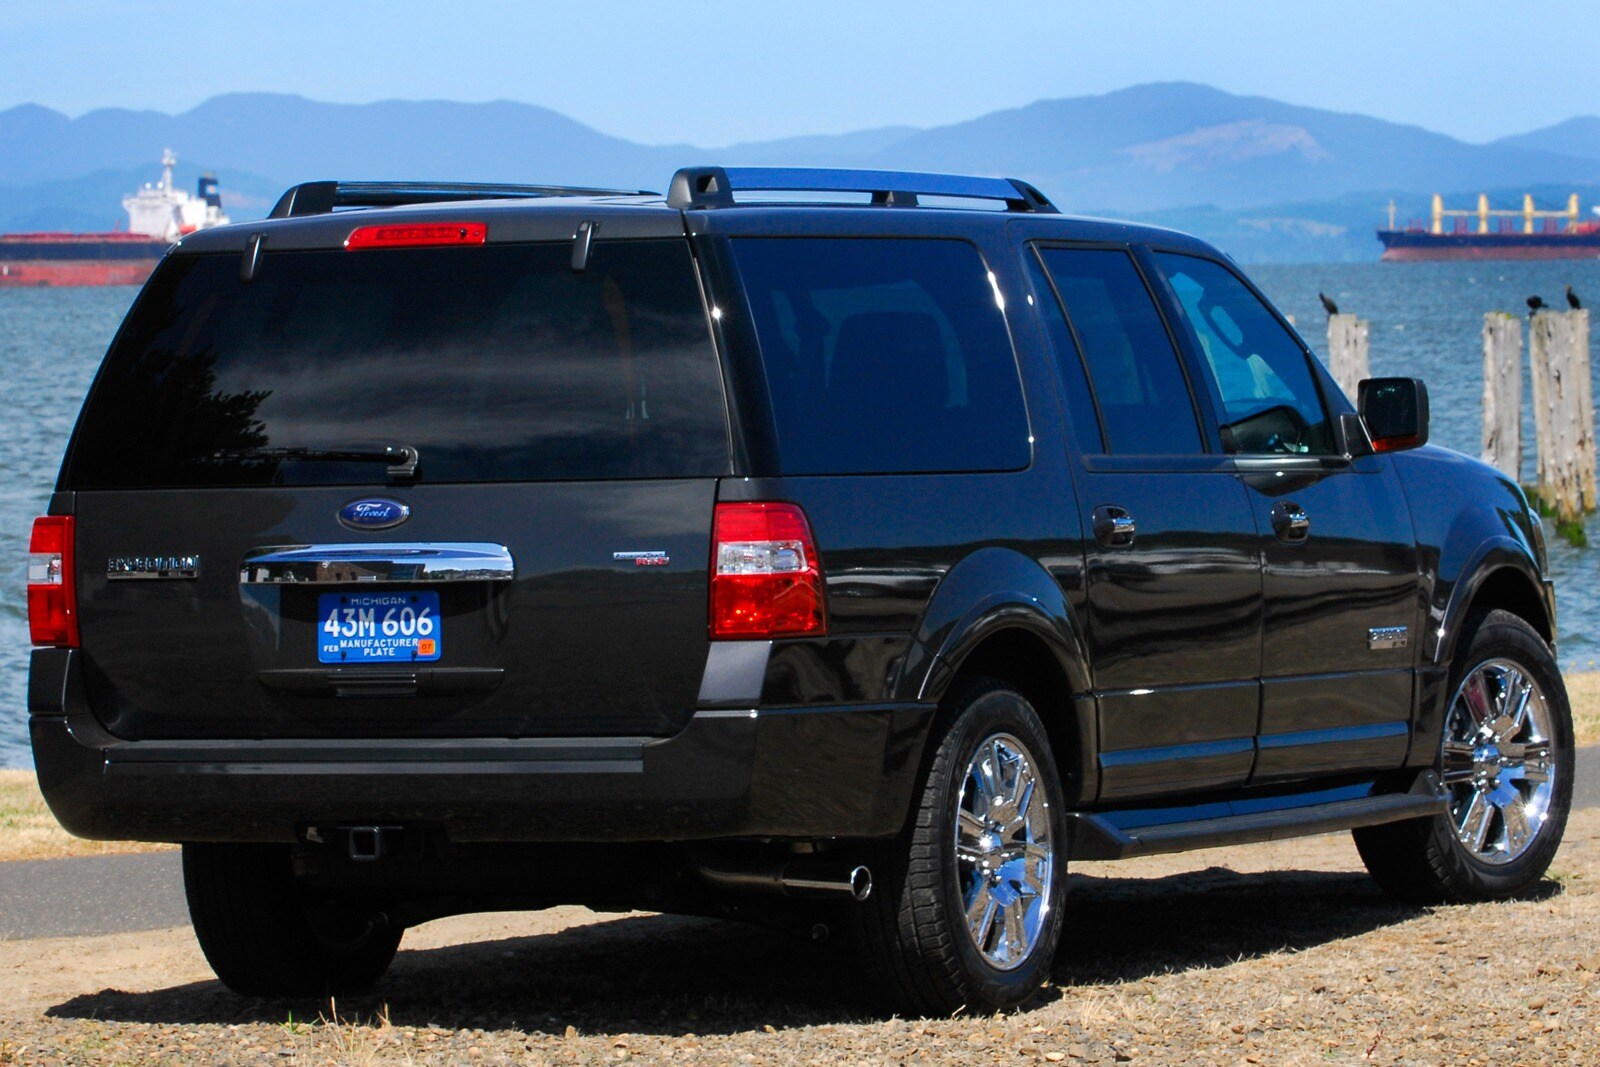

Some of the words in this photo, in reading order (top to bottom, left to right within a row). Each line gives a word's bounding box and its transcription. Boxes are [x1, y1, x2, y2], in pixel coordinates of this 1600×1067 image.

[351, 597, 406, 605] MICHIGAN
[324, 608, 376, 637] 43M
[382, 607, 433, 636] 606
[340, 638, 419, 648] MANUFACTURER
[363, 648, 395, 656] PLATE
